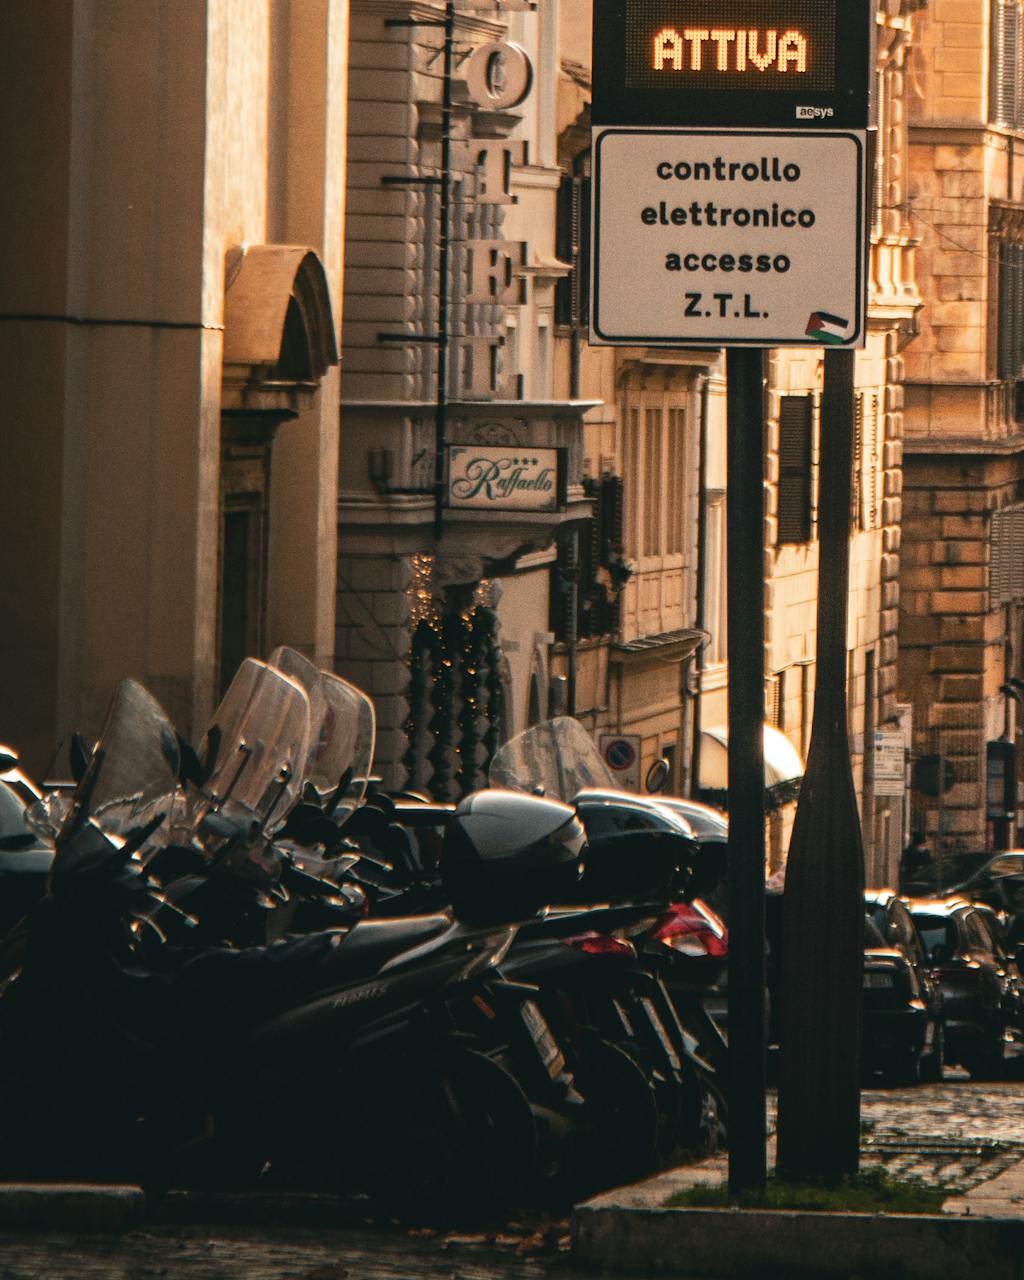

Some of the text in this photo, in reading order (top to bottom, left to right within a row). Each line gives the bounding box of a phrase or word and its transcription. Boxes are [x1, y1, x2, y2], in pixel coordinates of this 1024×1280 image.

[652, 28, 808, 73] ATTIVA
[656, 156, 801, 182] controllo
[640, 201, 817, 228] elettronico
[664, 248, 792, 274] accesso
[683, 292, 770, 319] Z.T.L.
[451, 457, 555, 500] Raffaello
